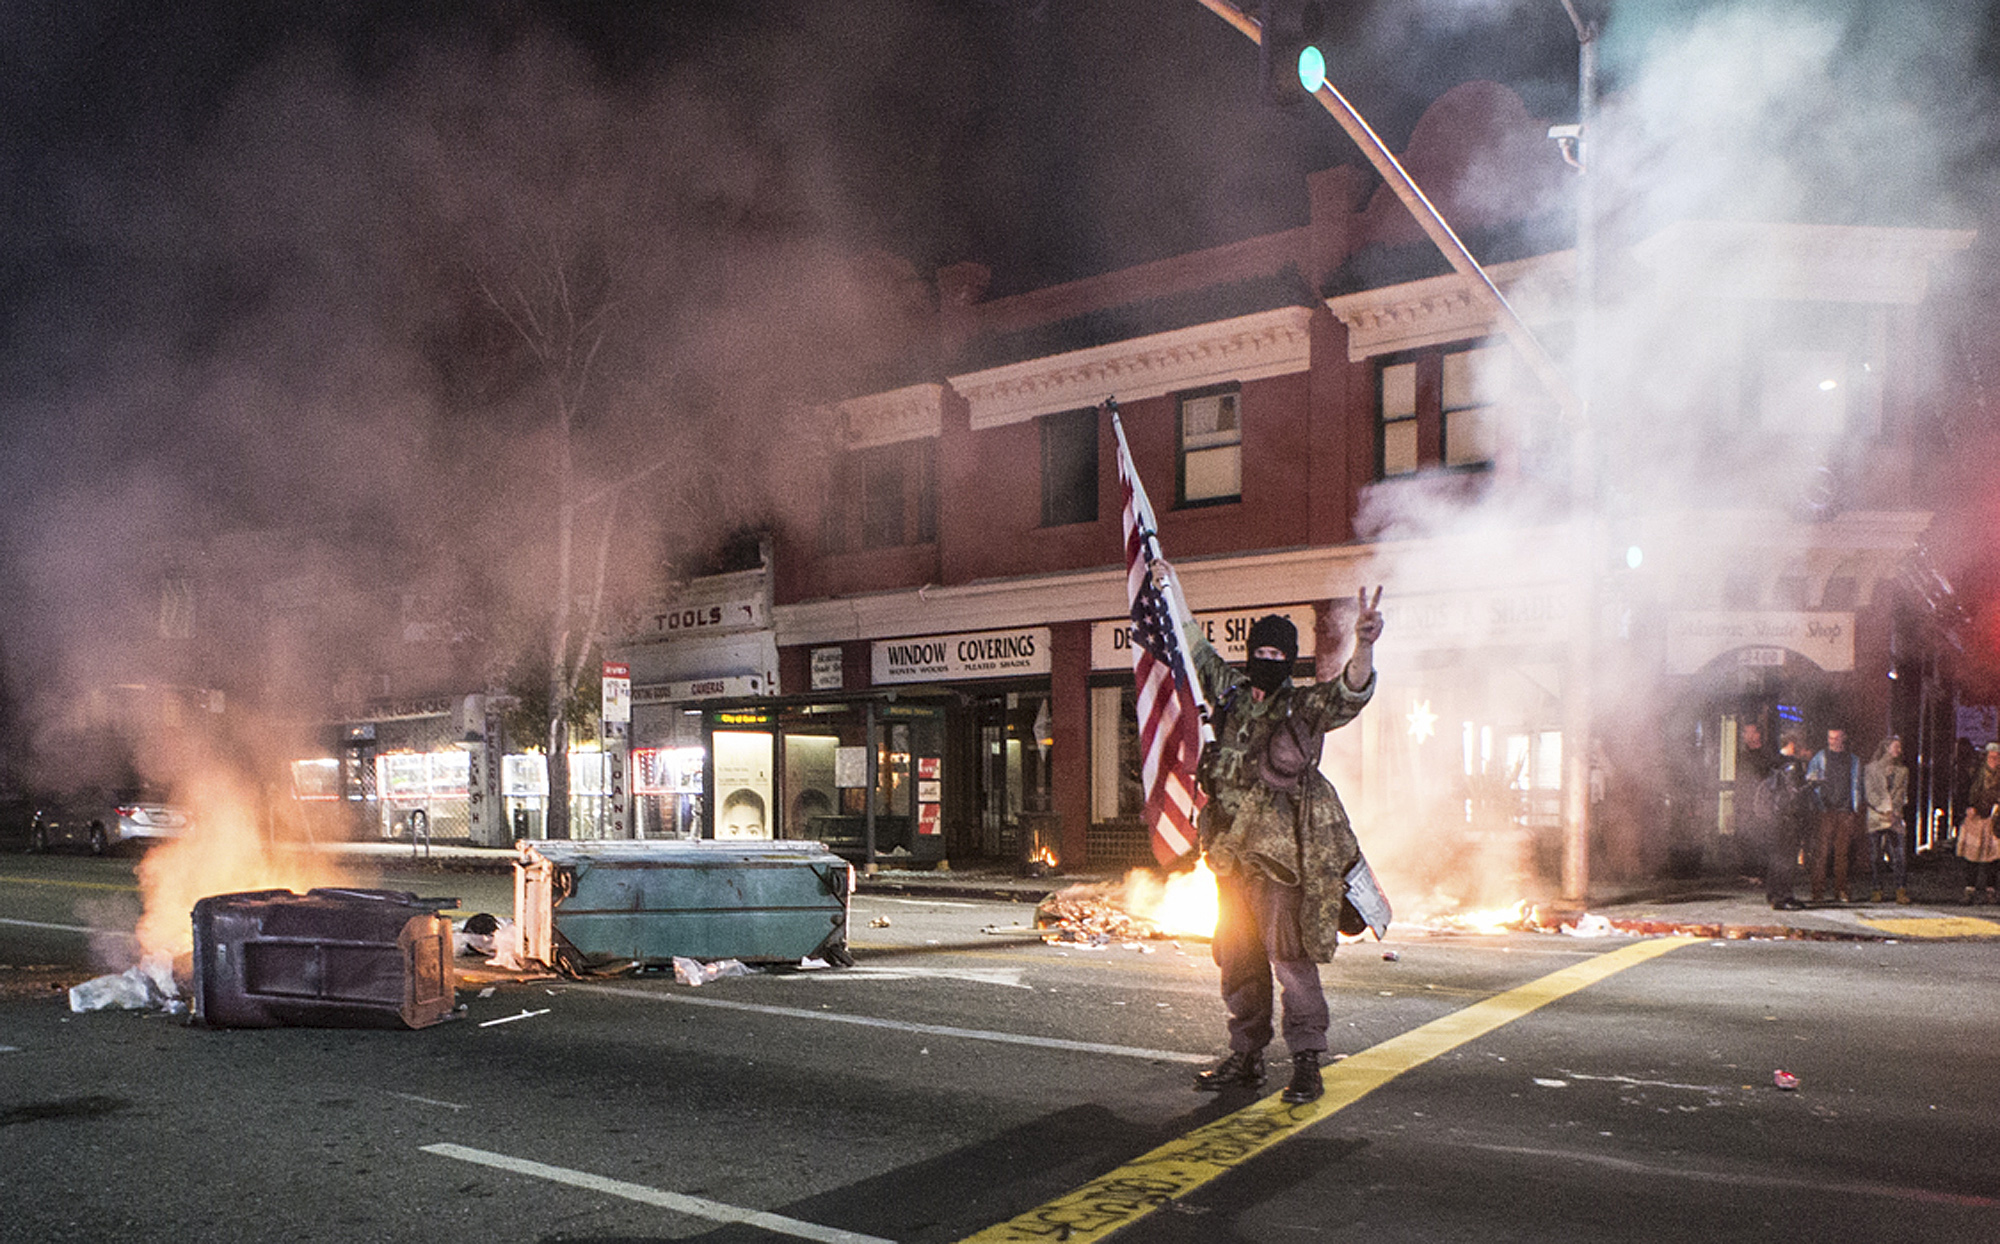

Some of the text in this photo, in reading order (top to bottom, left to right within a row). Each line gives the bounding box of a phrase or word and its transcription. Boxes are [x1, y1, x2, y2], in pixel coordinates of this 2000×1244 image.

[654, 607, 721, 630] TOOLS
[1805, 621, 1841, 643] Shop
[888, 635, 1035, 666] WINDOW COVERINGS
[920, 665, 948, 673] WOODS
[965, 663, 995, 671] PLEATED
[1000, 660, 1030, 668] SHADES
[691, 681, 724, 695] CAMERAS
[471, 756, 481, 824] CASH
[613, 752, 623, 831] LOANS
